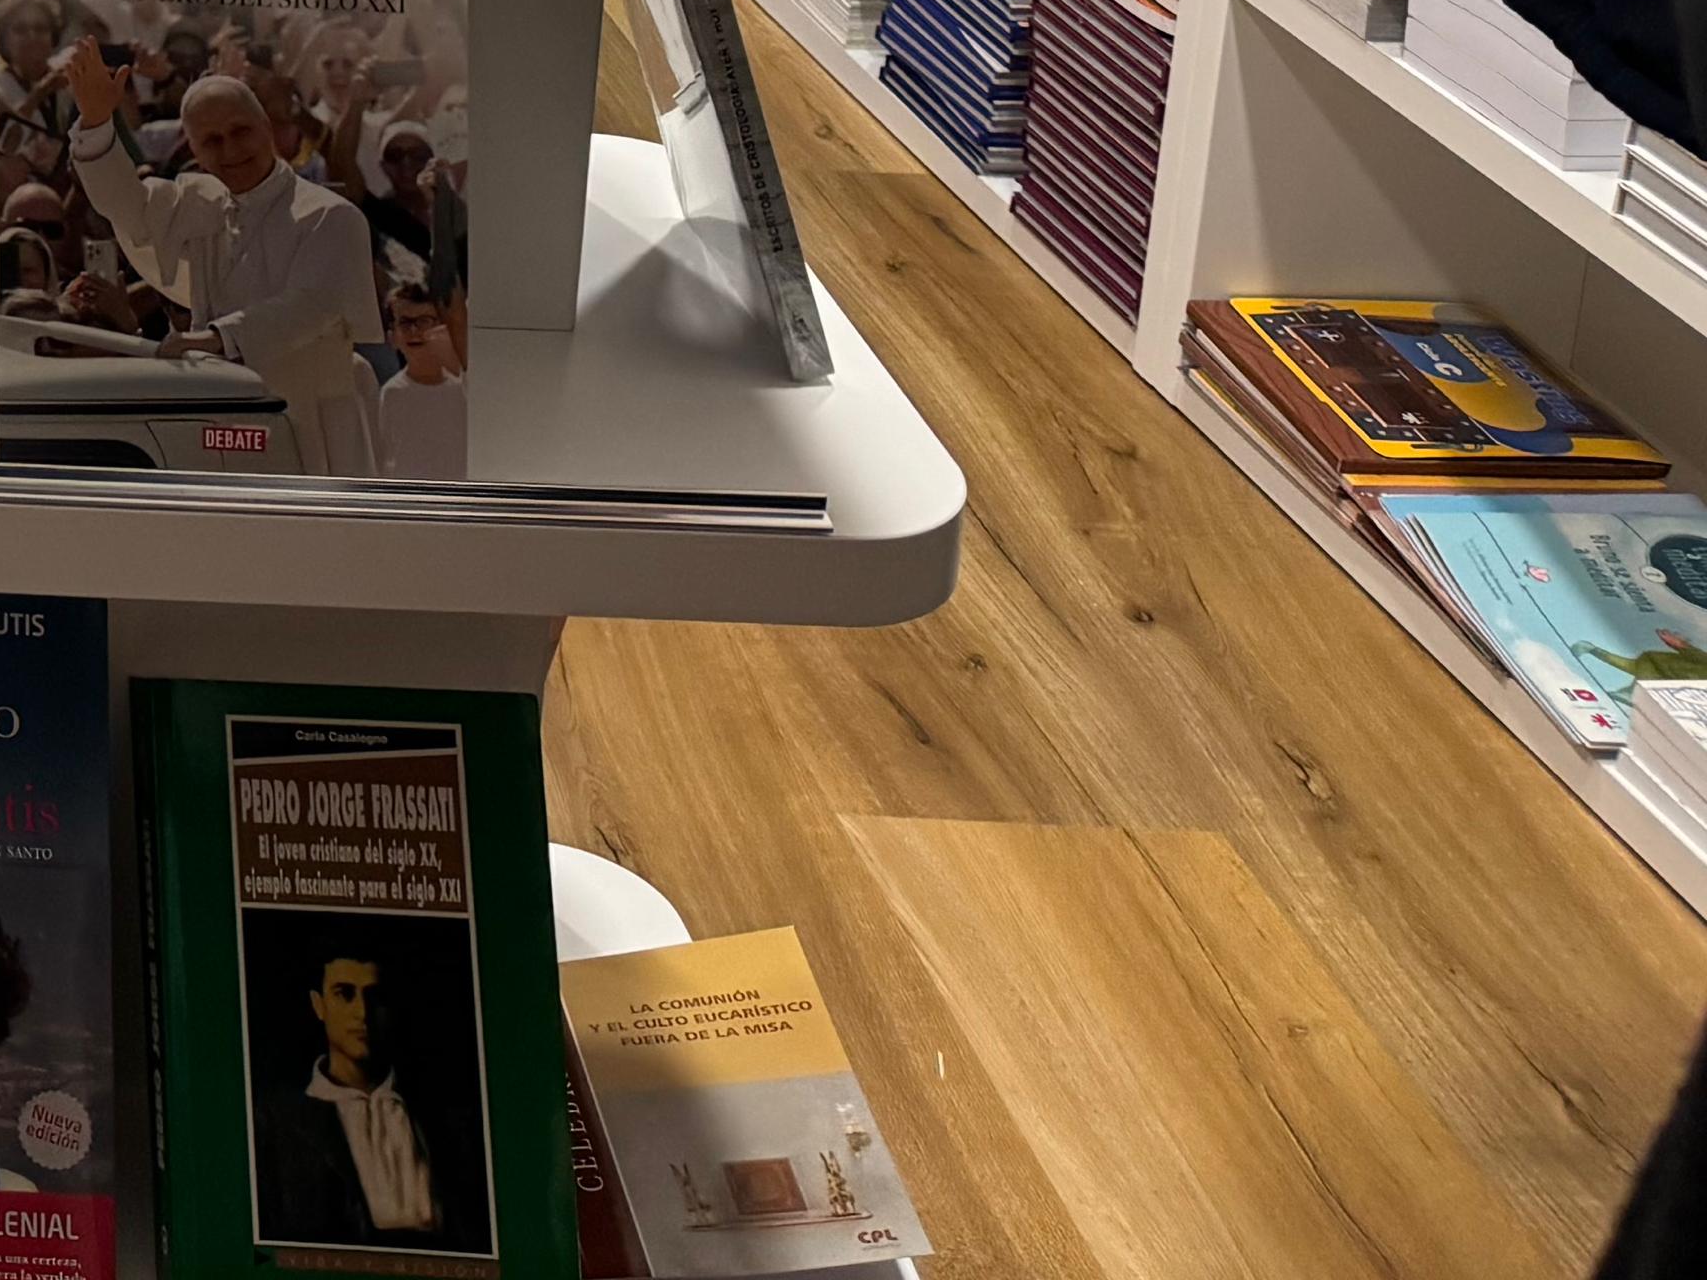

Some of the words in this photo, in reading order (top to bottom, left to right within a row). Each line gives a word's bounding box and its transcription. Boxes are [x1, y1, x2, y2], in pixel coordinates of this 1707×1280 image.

[204, 428, 268, 450] DEBATE
[240, 778, 300, 825] PEDRO
[307, 781, 366, 828] JORGE
[371, 784, 456, 832] FRASSATI
[629, 1002, 654, 1015] LA
[658, 989, 760, 1012] COMUNIÓN
[589, 1023, 601, 1034] Y
[607, 1020, 629, 1032] EL
[633, 1014, 689, 1031] CULTO
[693, 999, 813, 1025] EUCARÍSTICO
[621, 1031, 682, 1047] FUERA
[685, 1029, 711, 1041] DE
[715, 1027, 740, 1038] LA
[744, 1019, 793, 1035] MISA
